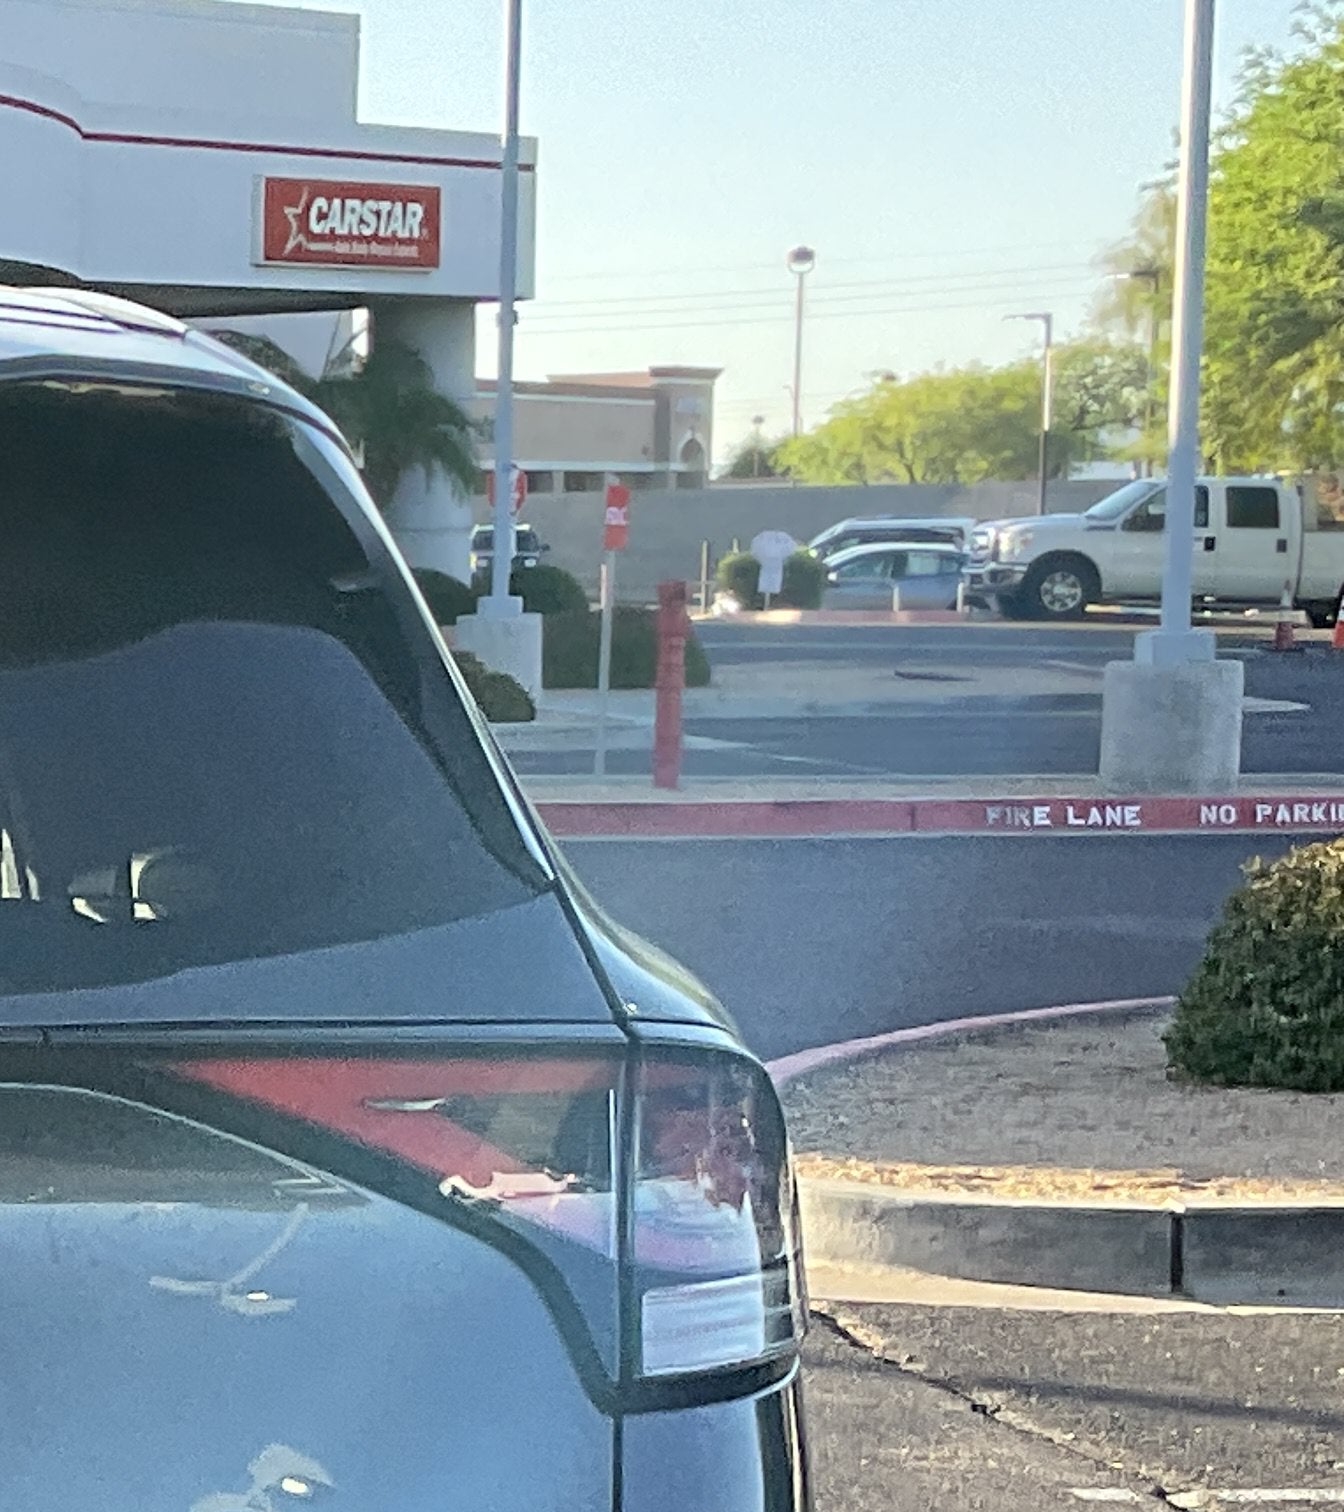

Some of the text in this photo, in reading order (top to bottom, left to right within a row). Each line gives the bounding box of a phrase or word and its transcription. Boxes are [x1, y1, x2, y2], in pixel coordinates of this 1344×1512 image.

[309, 197, 424, 239] CARSTAR
[985, 805, 1052, 828] FIRE
[1066, 805, 1143, 827] LANE
[1198, 804, 1237, 825] NO
